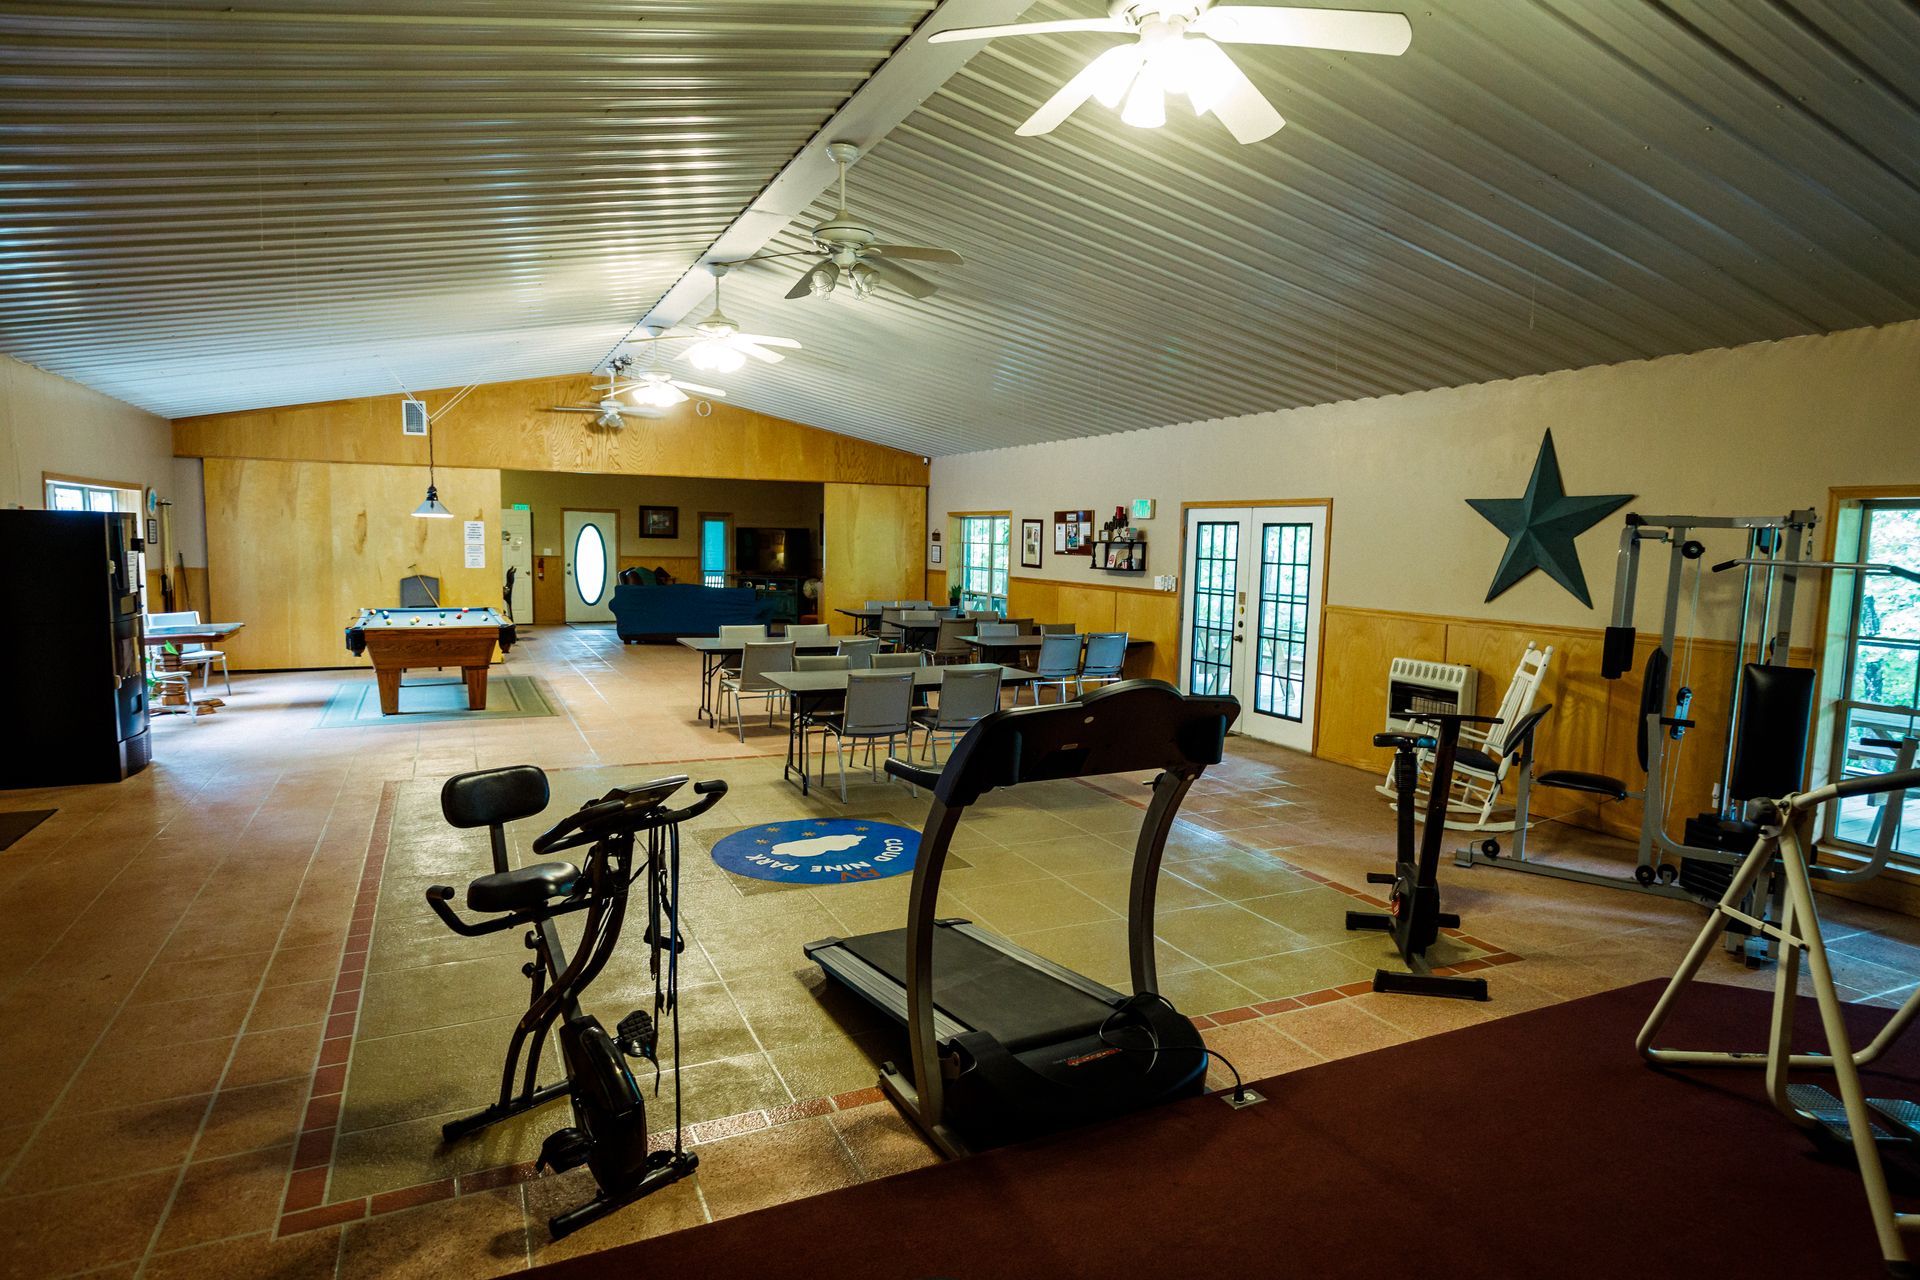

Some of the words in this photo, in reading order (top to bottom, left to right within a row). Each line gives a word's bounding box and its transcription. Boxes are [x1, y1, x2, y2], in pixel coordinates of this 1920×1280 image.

[874, 838, 904, 862] CLOUD
[745, 854, 800, 872] PARK
[810, 861, 871, 873] NINE
[841, 869, 881, 881] RV
